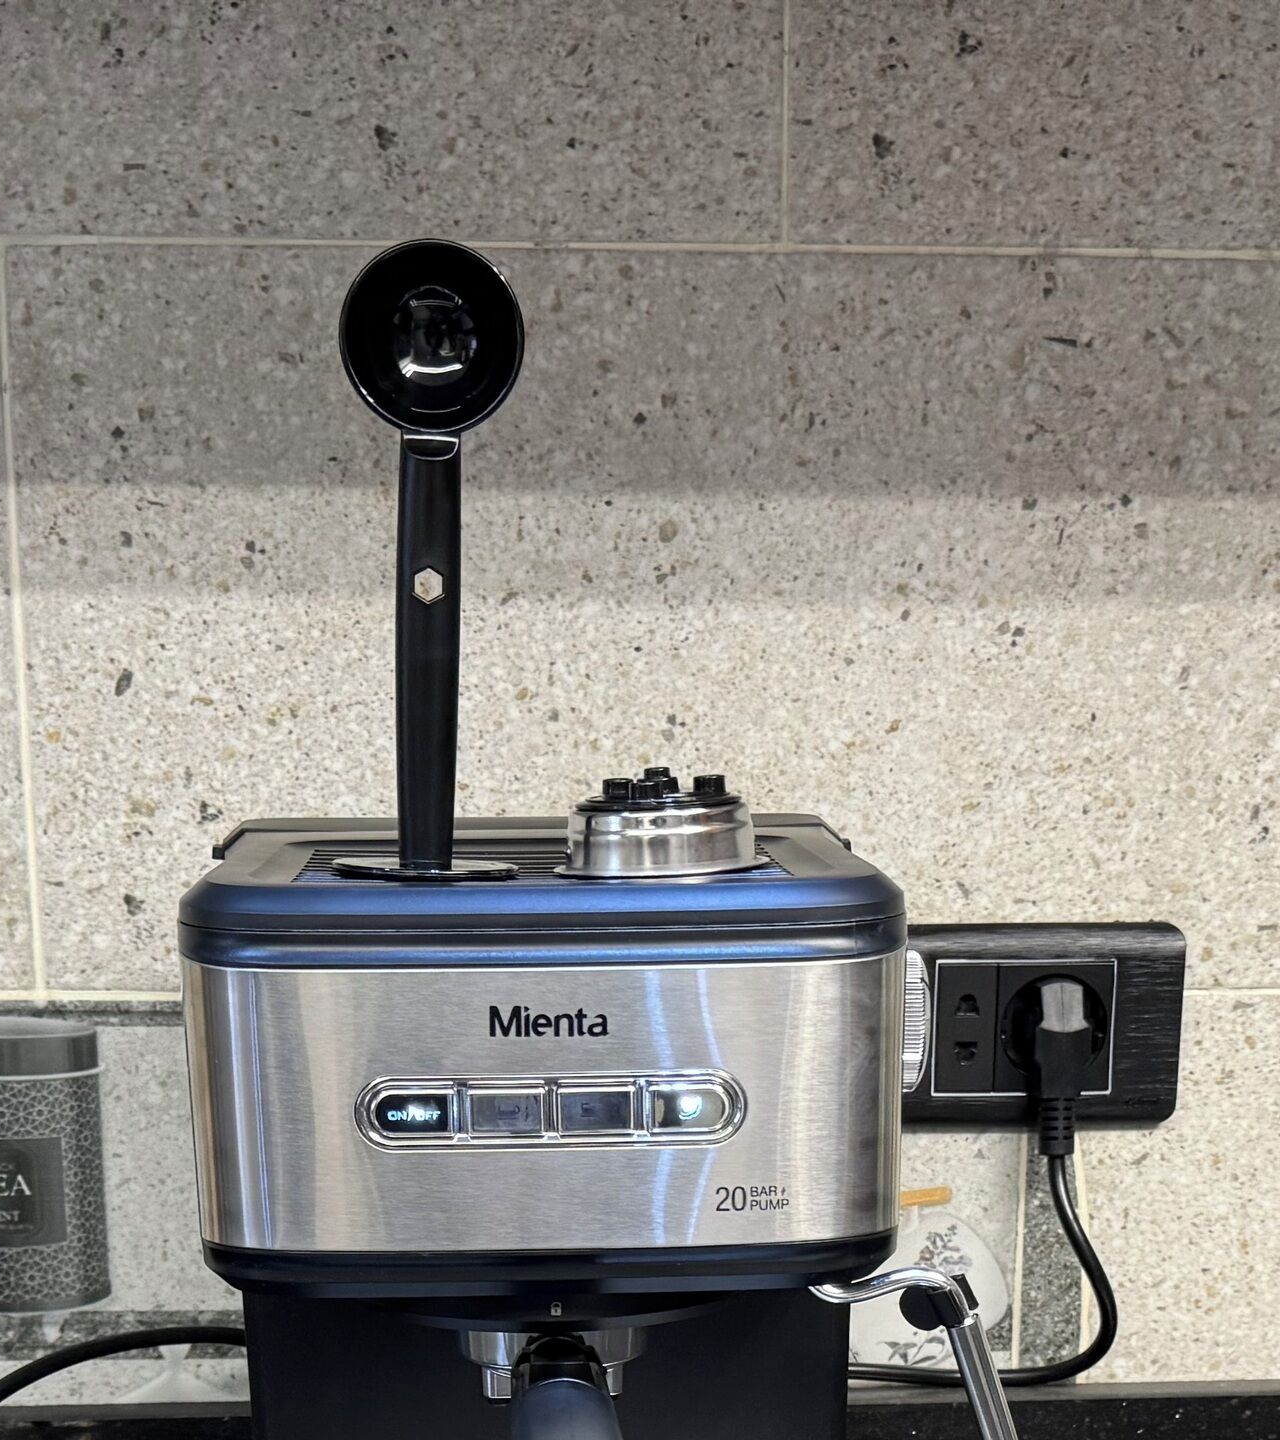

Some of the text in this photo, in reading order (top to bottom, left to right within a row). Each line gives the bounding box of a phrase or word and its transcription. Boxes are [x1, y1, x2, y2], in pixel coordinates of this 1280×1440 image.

[488, 1005, 609, 1037] Mienta
[386, 1105, 441, 1122] ON/OFF
[715, 1186, 778, 1212] 20 BAR
[750, 1199, 790, 1211] PUMP
